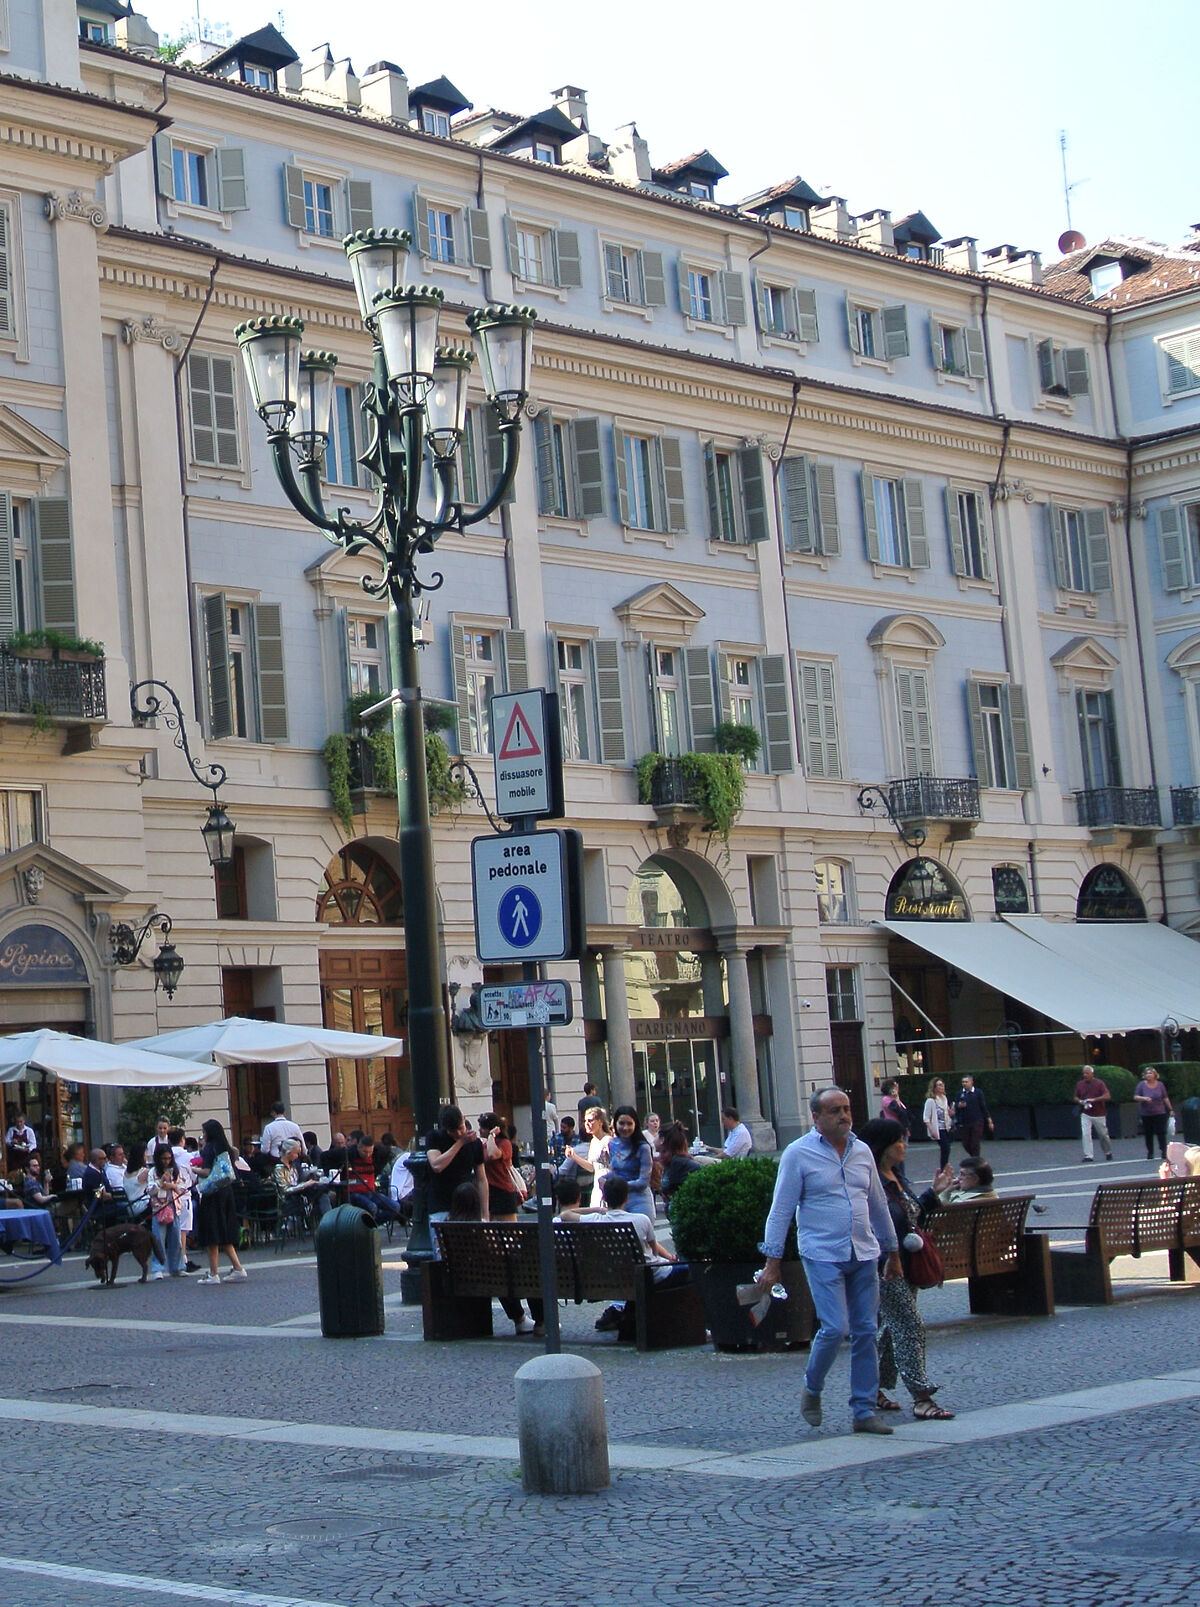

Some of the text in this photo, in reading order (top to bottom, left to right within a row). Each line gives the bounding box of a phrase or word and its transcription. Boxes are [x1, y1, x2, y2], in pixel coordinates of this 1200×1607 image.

[500, 768, 543, 781] dissuasore
[509, 787, 536, 798] mobile
[503, 845, 531, 857] area
[489, 860, 547, 880] pedonale
[895, 896, 959, 914] Ristorante
[639, 933, 690, 945] TEATRO
[636, 1021, 706, 1035] CARIGNANO
